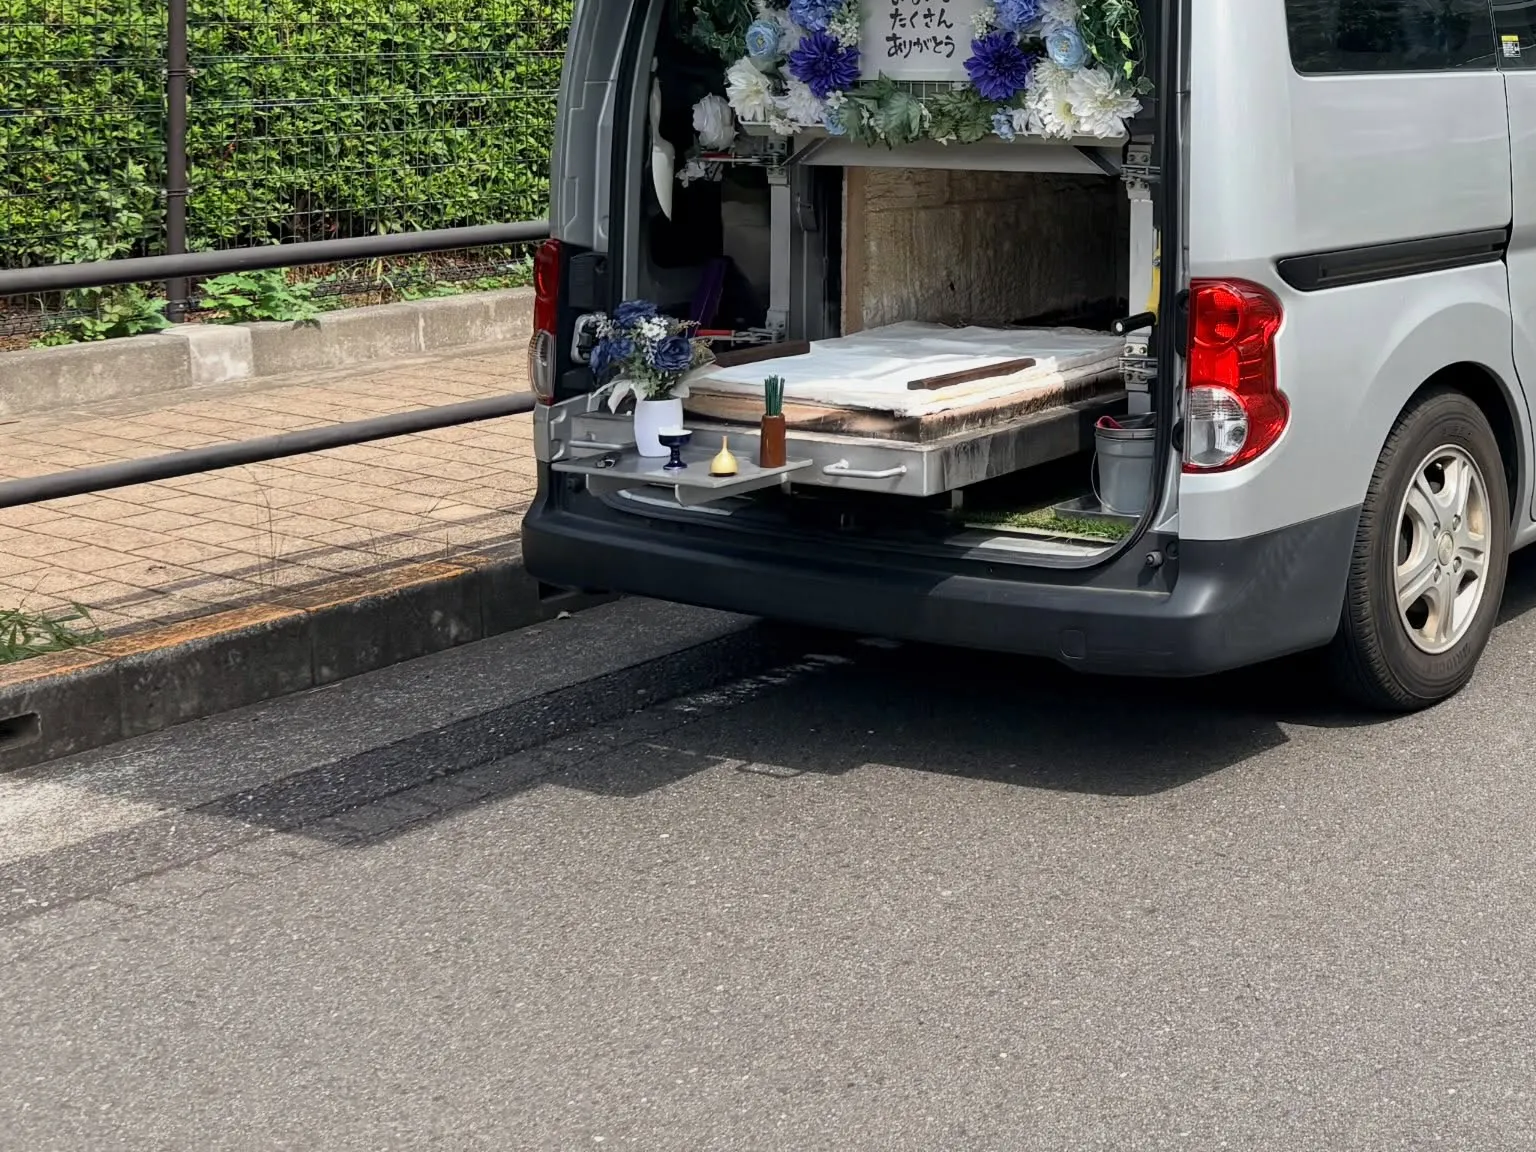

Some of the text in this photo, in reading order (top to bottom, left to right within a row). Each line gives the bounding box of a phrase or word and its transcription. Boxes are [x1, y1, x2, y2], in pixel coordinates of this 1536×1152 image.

[890, 8, 953, 30] たくさん
[886, 33, 955, 58] ありがとう
